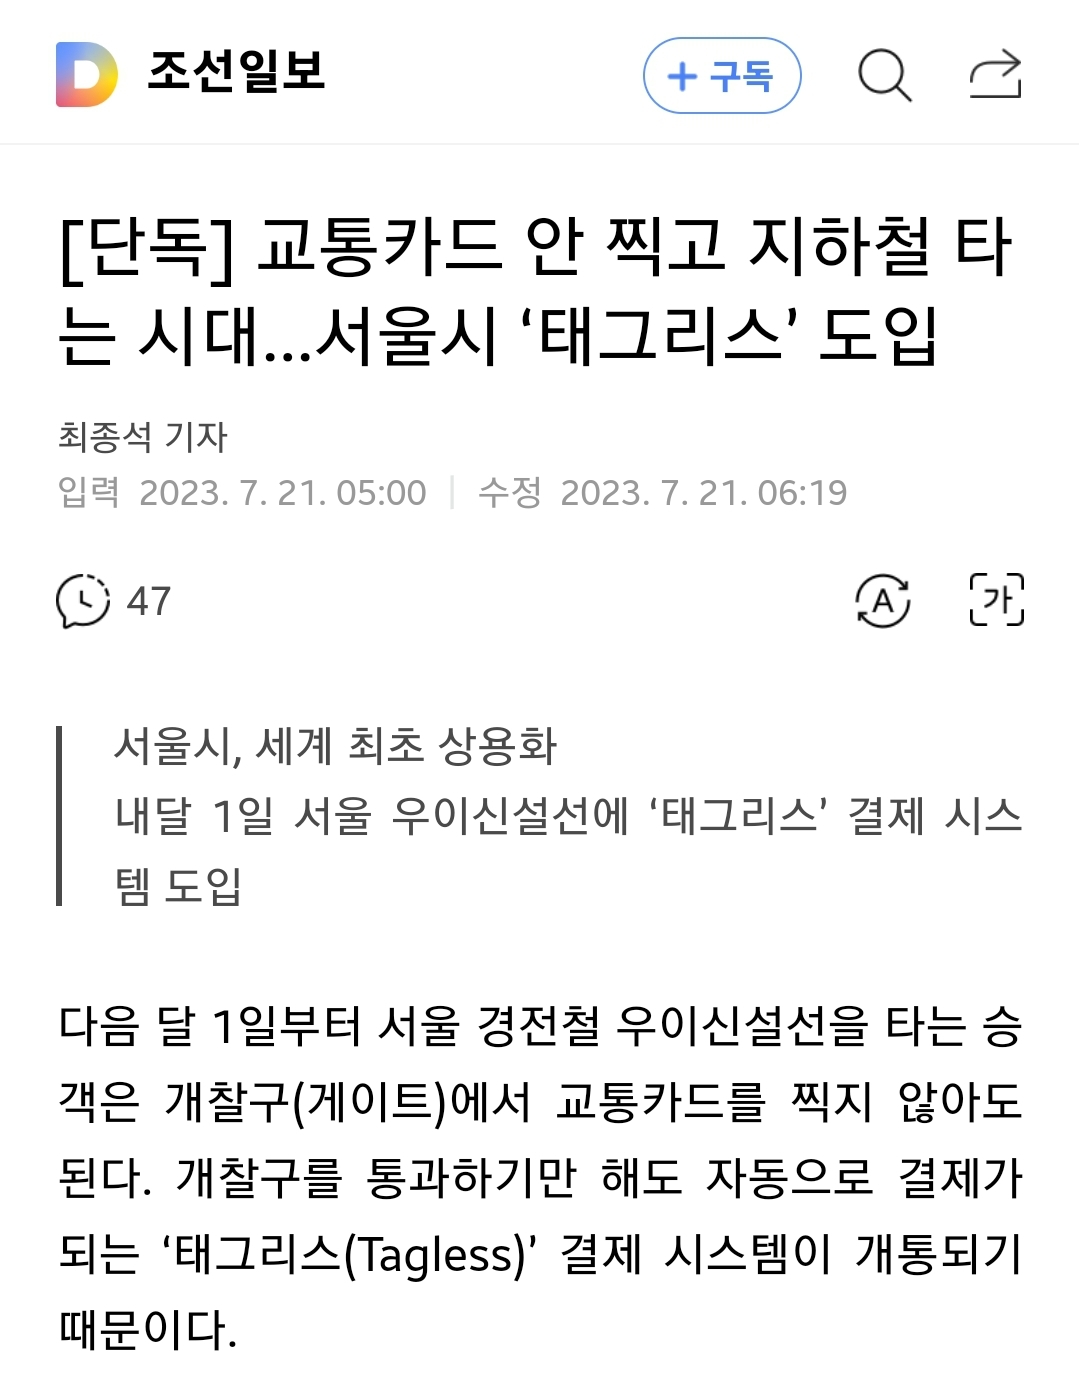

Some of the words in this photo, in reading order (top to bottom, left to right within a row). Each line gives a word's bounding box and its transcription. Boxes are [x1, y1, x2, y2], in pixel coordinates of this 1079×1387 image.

[147, 48, 326, 94] 조선일보
[709, 60, 774, 93] 구독
[62, 216, 232, 288] [단독]
[257, 216, 503, 278] 교통카드
[526, 216, 585, 276] 안
[606, 216, 726, 278] 찍고
[748, 216, 929, 278] 지하철
[957, 216, 1013, 278] 타
[58, 306, 117, 366] 는
[819, 306, 935, 367] 도입
[58, 421, 151, 455] 최종석
[165, 421, 228, 454] 기자
[58, 476, 118, 509] 입력
[140, 479, 228, 506] 2023.
[240, 479, 267, 506] 7.
[278, 479, 326, 506] 21.
[336, 479, 427, 506] 05:00
[478, 476, 540, 509] 수정
[561, 479, 650, 506] 2023.
[661, 479, 688, 506] 7.
[699, 479, 747, 506] 21.
[758, 479, 847, 506] 06:19
[126, 585, 172, 616] 47
[113, 726, 242, 770] 서울시,
[255, 726, 331, 766] 세계
[348, 726, 425, 766] 최초
[438, 726, 558, 767] 상용화
[116, 796, 192, 836] 내달
[214, 796, 272, 836] 1일
[294, 796, 372, 836] 서울
[392, 796, 627, 837] 우이신설선에
[848, 796, 923, 836] 결제
[944, 796, 1023, 836] 시스
[116, 867, 149, 907] 템
[164, 867, 240, 907] 도입
[60, 1005, 140, 1048] 다음
[158, 1005, 197, 1047] 달
[213, 1005, 359, 1048] 1일부터
[377, 1005, 461, 1048] 서울
[477, 1005, 599, 1049] 경전철
[616, 1005, 869, 1048] 우이신설선을
[887, 1005, 967, 1048] 타는
[982, 1005, 1023, 1048] 승
[58, 1081, 140, 1124] 객은
[164, 1080, 529, 1131] 개찰구(게이트)에서
[556, 1081, 767, 1125] 교통카드를
[791, 1081, 871, 1124] 찍지
[898, 1081, 1023, 1124] 않아도
[59, 1233, 140, 1276] 되는
[560, 1233, 641, 1276] 결제
[664, 1233, 829, 1276] 시스템이
[855, 1233, 1019, 1277] 개통되기
[60, 1309, 237, 1352] 때문이다.
